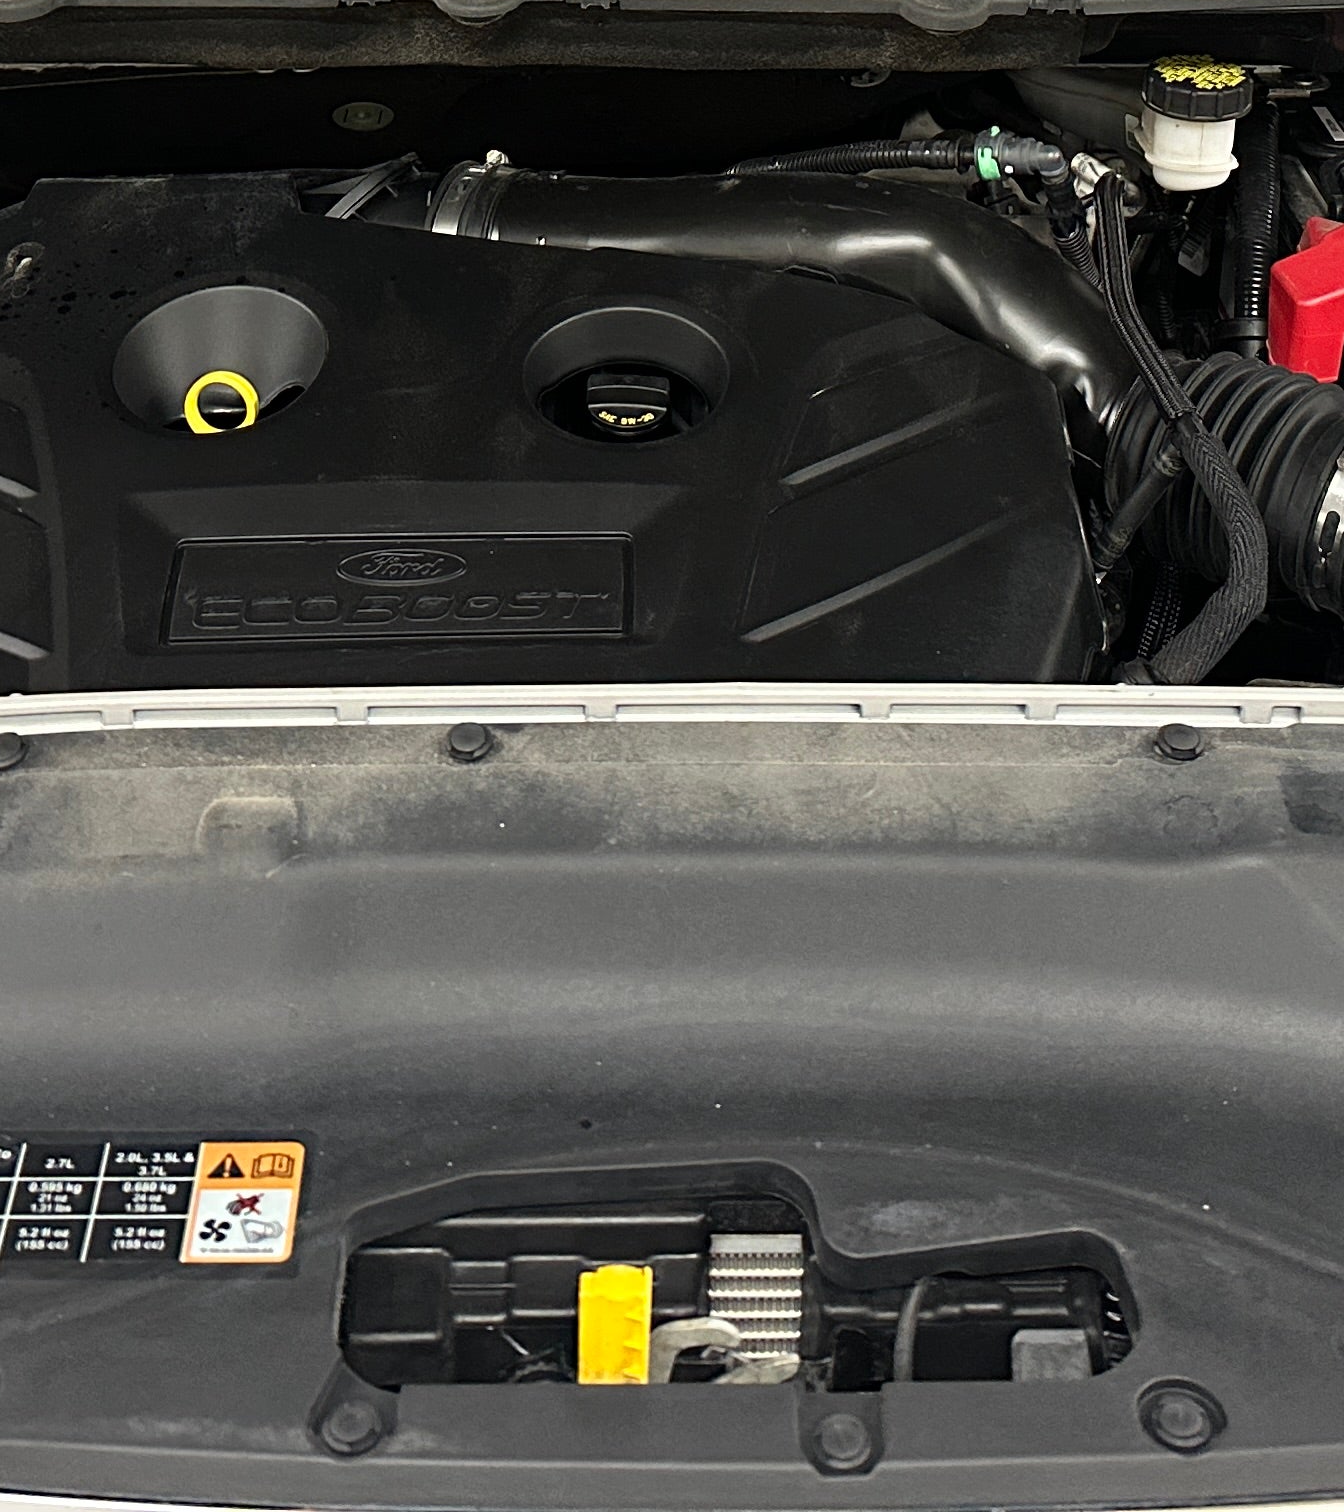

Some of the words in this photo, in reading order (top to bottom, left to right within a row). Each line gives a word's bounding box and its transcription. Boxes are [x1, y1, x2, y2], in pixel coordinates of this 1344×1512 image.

[598, 411, 618, 423] SAE
[360, 551, 446, 578] Ford
[44, 1158, 75, 1169] 2.7L
[137, 1166, 167, 1176] 3.7L
[66, 1182, 83, 1196] kg
[159, 1182, 177, 1196] kg
